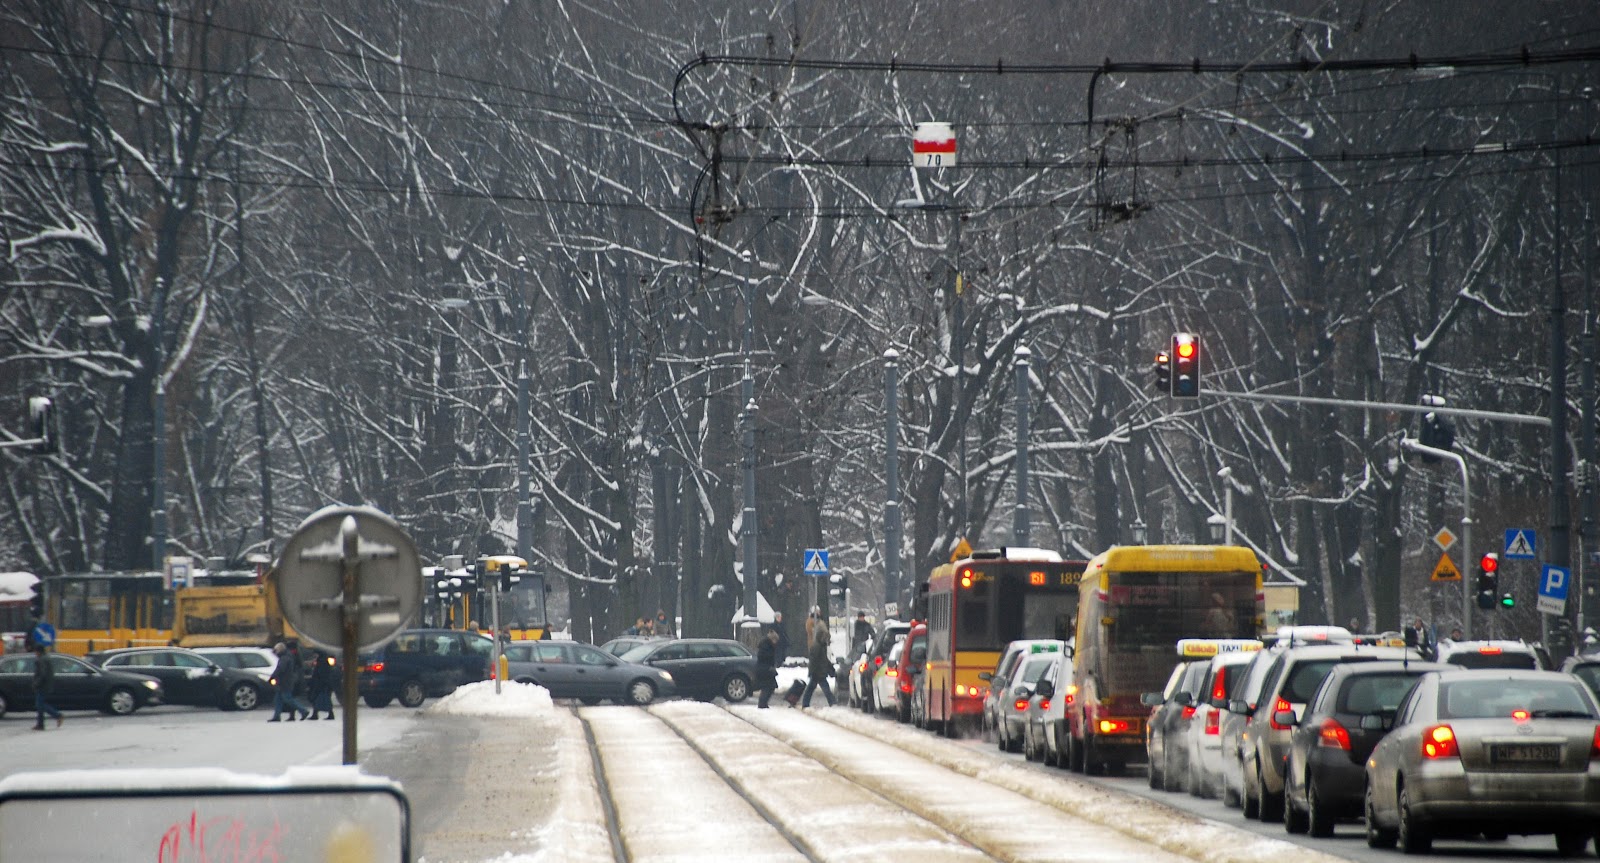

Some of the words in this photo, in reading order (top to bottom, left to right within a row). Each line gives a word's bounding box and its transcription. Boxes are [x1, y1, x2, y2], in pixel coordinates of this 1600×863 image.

[927, 154, 941, 165] 70
[1031, 573, 1044, 584] 151
[1545, 568, 1564, 593] P
[1222, 644, 1239, 652] TAXI
